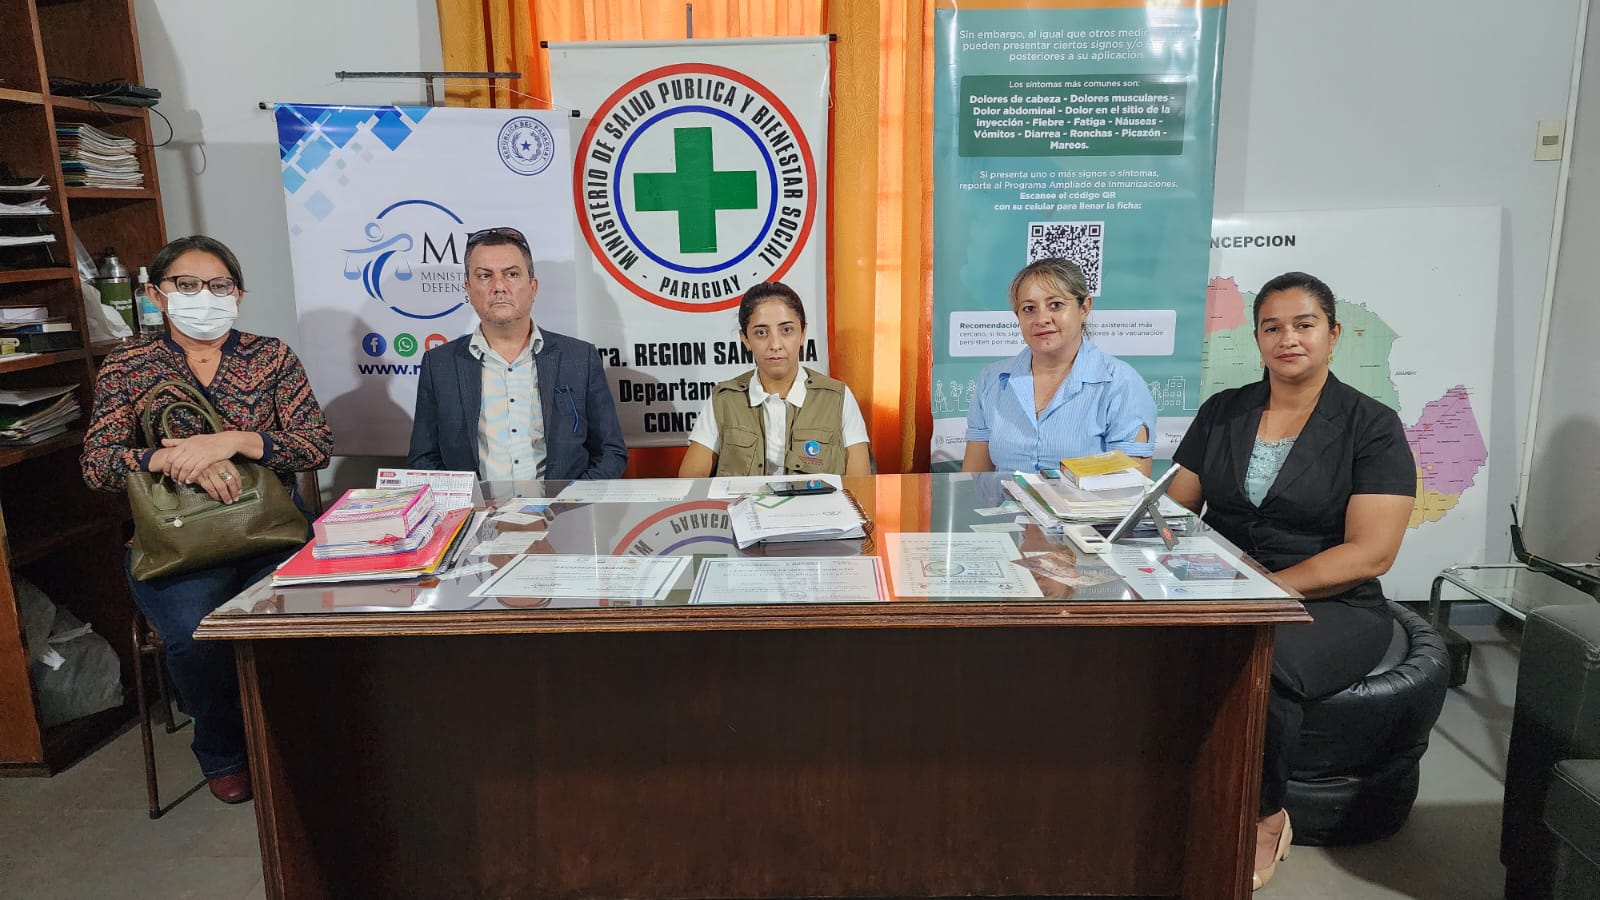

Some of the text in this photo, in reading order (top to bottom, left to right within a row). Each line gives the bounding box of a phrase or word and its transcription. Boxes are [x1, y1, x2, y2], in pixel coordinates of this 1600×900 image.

[960, 30, 974, 39] Sin
[978, 30, 1025, 40] embargo,
[1028, 29, 1037, 39] al
[1040, 29, 1064, 40] igual
[1066, 31, 1086, 40] que
[1088, 30, 1116, 38] otros
[963, 39, 1143, 51] pueden presentar ciertos signos y/o
[1009, 52, 1065, 62] posteriores
[1064, 80, 1081, 88] más
[969, 95, 1008, 103] Dolores
[1010, 94, 1023, 103] de
[1025, 94, 1061, 103] cabeza
[1070, 94, 1109, 103] Dolores
[1111, 93, 1169, 103] musculares
[973, 106, 1001, 115] Dolor
[1003, 106, 1056, 115] abdominal
[1065, 106, 1094, 114] Dolor
[1110, 105, 1120, 114] el
[1122, 105, 1144, 114] sitio
[1146, 105, 1159, 114] de
[1161, 105, 1170, 114] la
[1032, 118, 1065, 127] Fiebre
[1073, 117, 1106, 127] Fatiga
[1114, 117, 1157, 126] Náuseas
[974, 129, 1016, 138] Vómitos
[1024, 129, 1061, 138] Diarrea
[1069, 128, 1113, 138] Ronchas
[1121, 128, 1161, 137] Picazón
[1049, 141, 1089, 150] Mareos.
[587, 77, 804, 271] MINISTERIO DE SALUD PUBLICA Y BIENESTAR SOCIAL
[980, 170, 988, 179] Si
[990, 171, 1028, 179] presenta
[1058, 169, 1076, 178] más
[1078, 170, 1107, 179] signos
[1117, 169, 1159, 178] síntomas,
[959, 182, 992, 190] reporte
[994, 181, 1002, 189] al
[1004, 181, 1047, 190] Programa
[1049, 180, 1092, 189] Ampliado
[1094, 180, 1106, 188] de
[1058, 191, 1067, 199] el
[1068, 191, 1100, 200] código
[1102, 191, 1117, 199] QR
[994, 203, 1010, 211] con
[1012, 203, 1022, 211] su
[1024, 202, 1055, 210] celular
[1056, 203, 1077, 212] para
[1079, 202, 1105, 210] llenar
[1117, 201, 1142, 209] ficha:
[1210, 234, 1297, 249] NCEPCION
[659, 274, 742, 300] PARAGUAY
[597, 347, 628, 367] ra.
[634, 342, 707, 367] REGION
[619, 378, 716, 406] Departam
[644, 411, 701, 433] CONC
